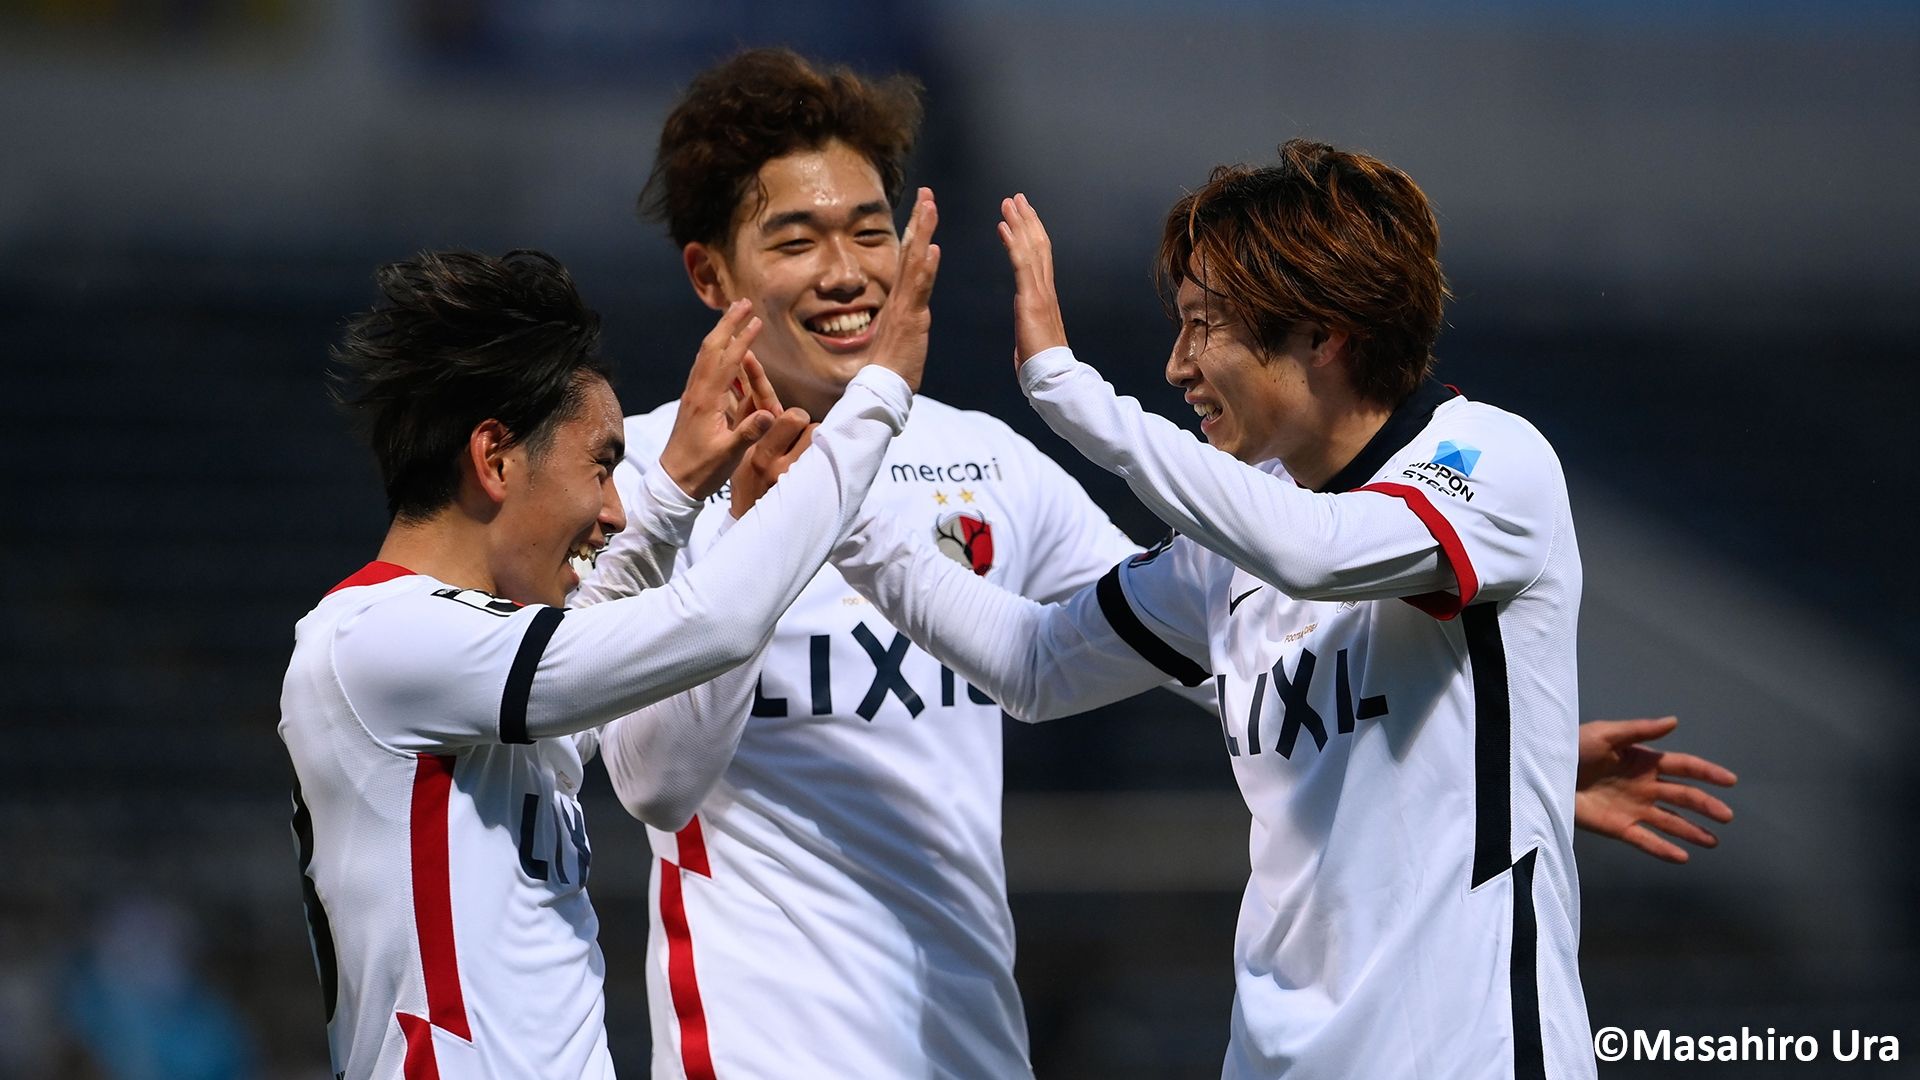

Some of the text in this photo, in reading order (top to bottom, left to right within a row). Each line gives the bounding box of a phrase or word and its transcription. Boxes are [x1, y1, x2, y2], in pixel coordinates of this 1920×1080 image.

[891, 457, 1002, 482] mercari
[751, 621, 998, 723] LIXI
[519, 793, 592, 888] LIX
